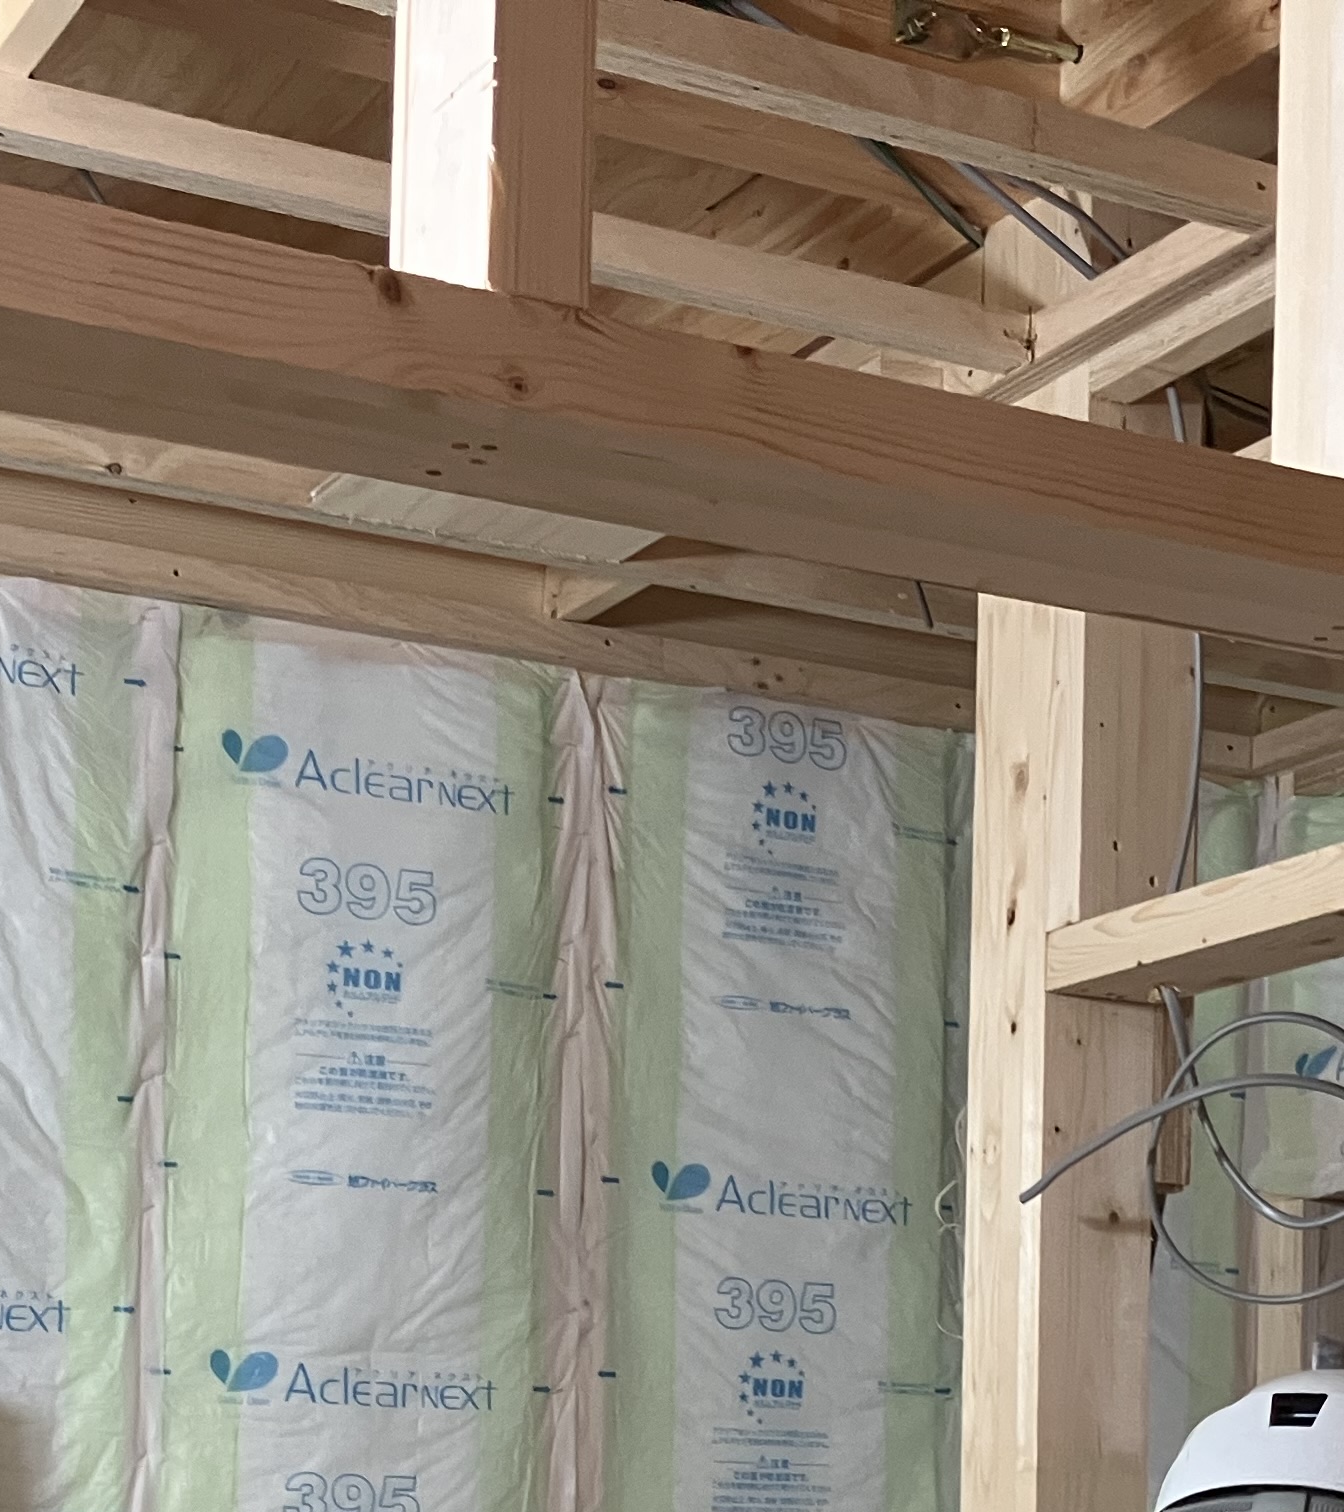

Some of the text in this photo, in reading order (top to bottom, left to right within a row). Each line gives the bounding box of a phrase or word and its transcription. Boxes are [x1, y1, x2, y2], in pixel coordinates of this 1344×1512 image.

[727, 706, 847, 771] 395
[766, 808, 816, 834] NON
[297, 857, 437, 925] 395
[343, 967, 402, 992] NON
[714, 1276, 838, 1334] 395
[753, 1377, 803, 1399] NON
